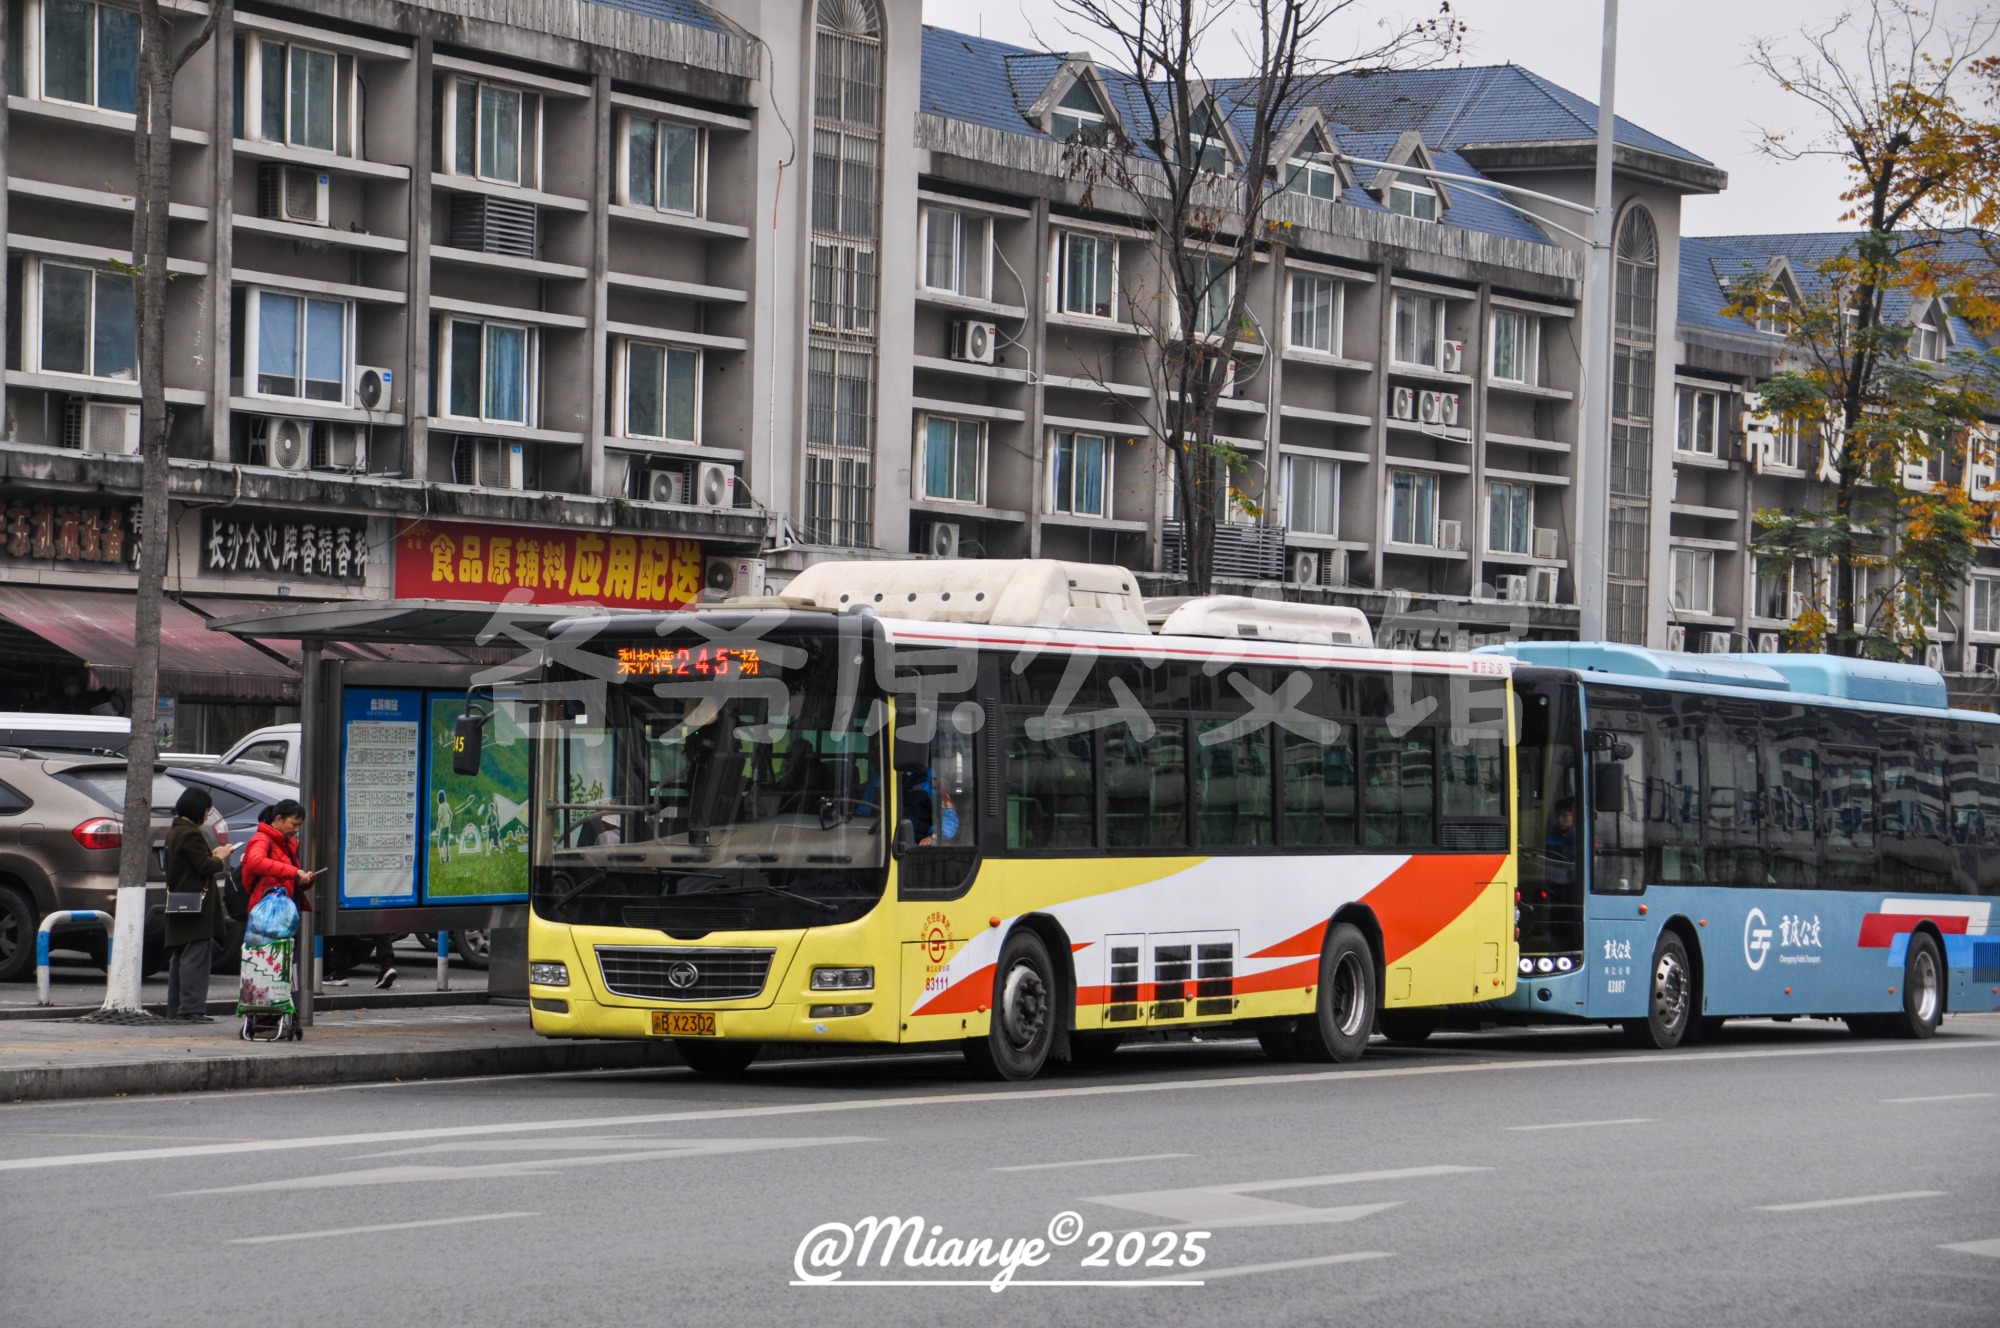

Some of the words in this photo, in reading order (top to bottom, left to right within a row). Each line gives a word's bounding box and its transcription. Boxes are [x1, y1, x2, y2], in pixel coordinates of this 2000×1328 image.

[430, 531, 702, 605] 食品原辅料应用配送
[677, 648, 729, 675] 245
[453, 735, 465, 752] 45
[1779, 914, 1823, 948] 重庆公交
[925, 977, 949, 991] 83111
